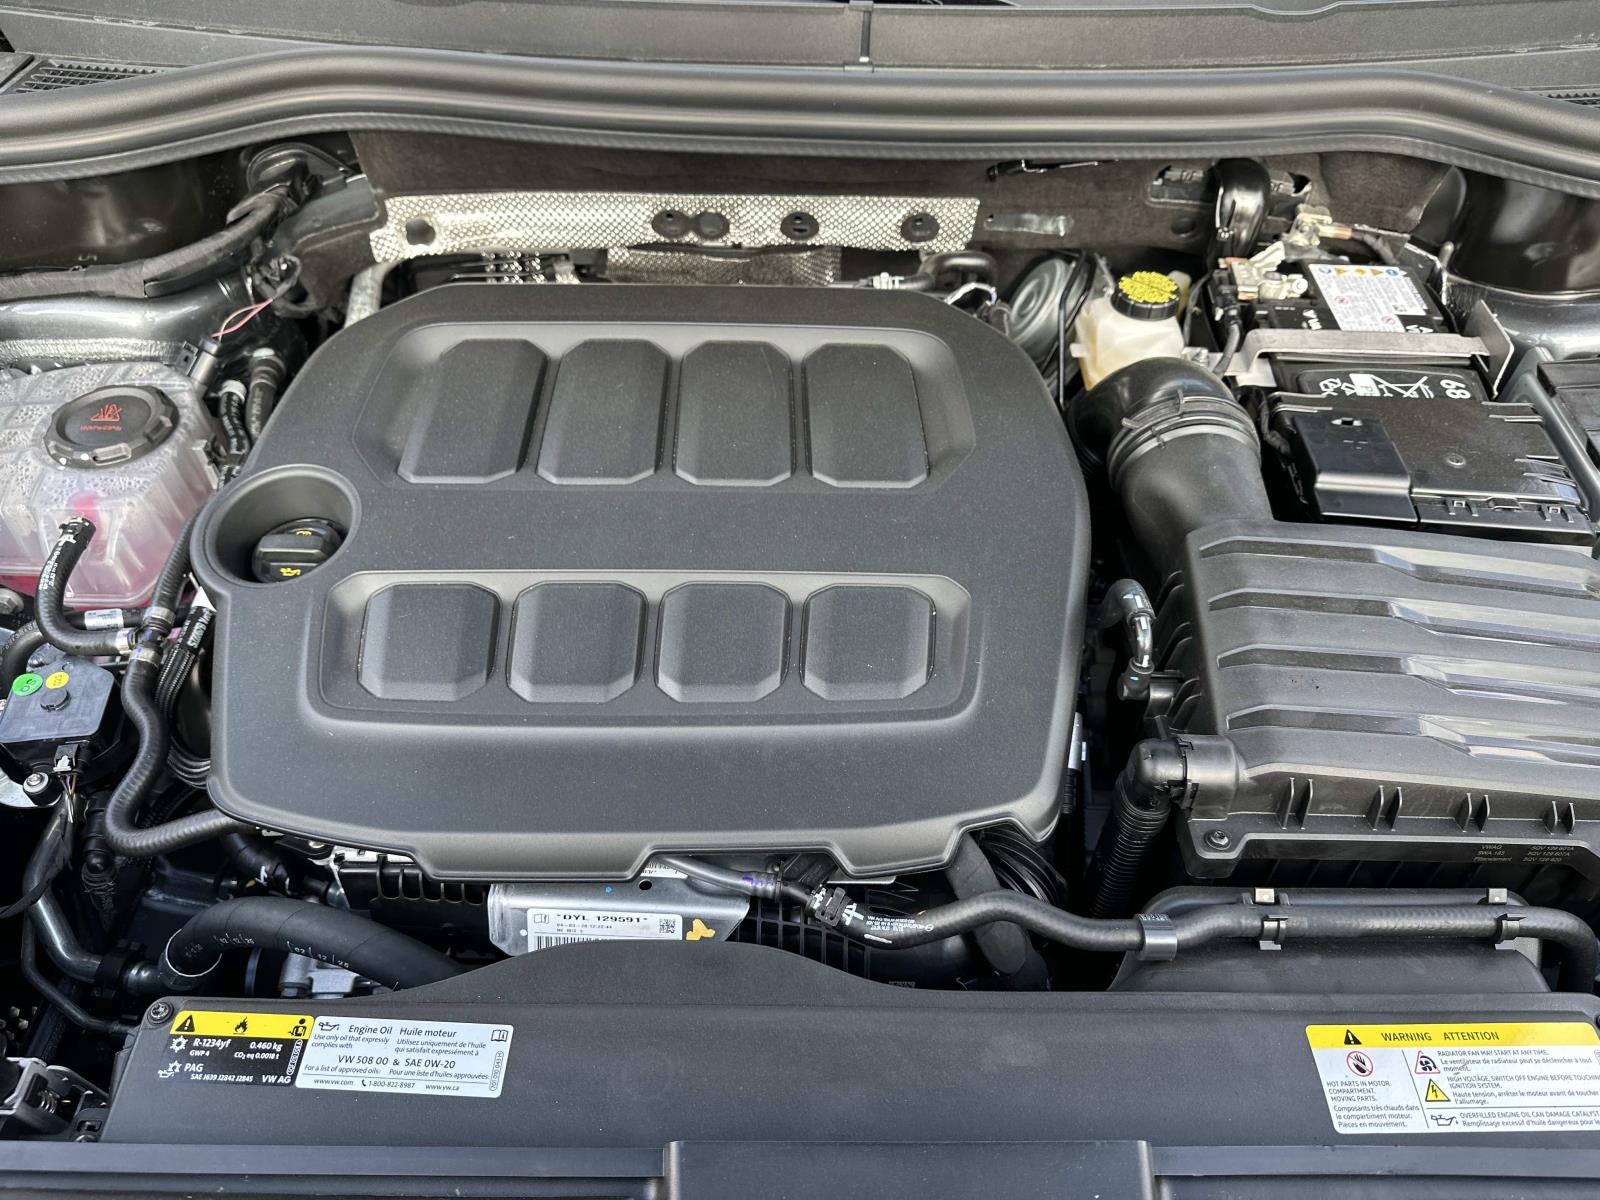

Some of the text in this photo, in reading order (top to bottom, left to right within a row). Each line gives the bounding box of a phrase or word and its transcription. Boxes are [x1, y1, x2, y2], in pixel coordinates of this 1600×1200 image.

[1440, 380, 1470, 398] 68
[349, 1025, 378, 1035] Engine
[400, 1027, 423, 1036] Huile
[1381, 1032, 1500, 1041] WARNING ATTENTION
[193, 1038, 231, 1049] R-1234yf
[273, 1042, 283, 1051] kg
[356, 1056, 374, 1064] 508
[376, 1056, 389, 1065] 00
[405, 1058, 421, 1067] SAE
[424, 1059, 456, 1069] 0W-20
[184, 1063, 203, 1072] PAG
[430, 1070, 452, 1078] d'huiles
[277, 1075, 291, 1084] AG
